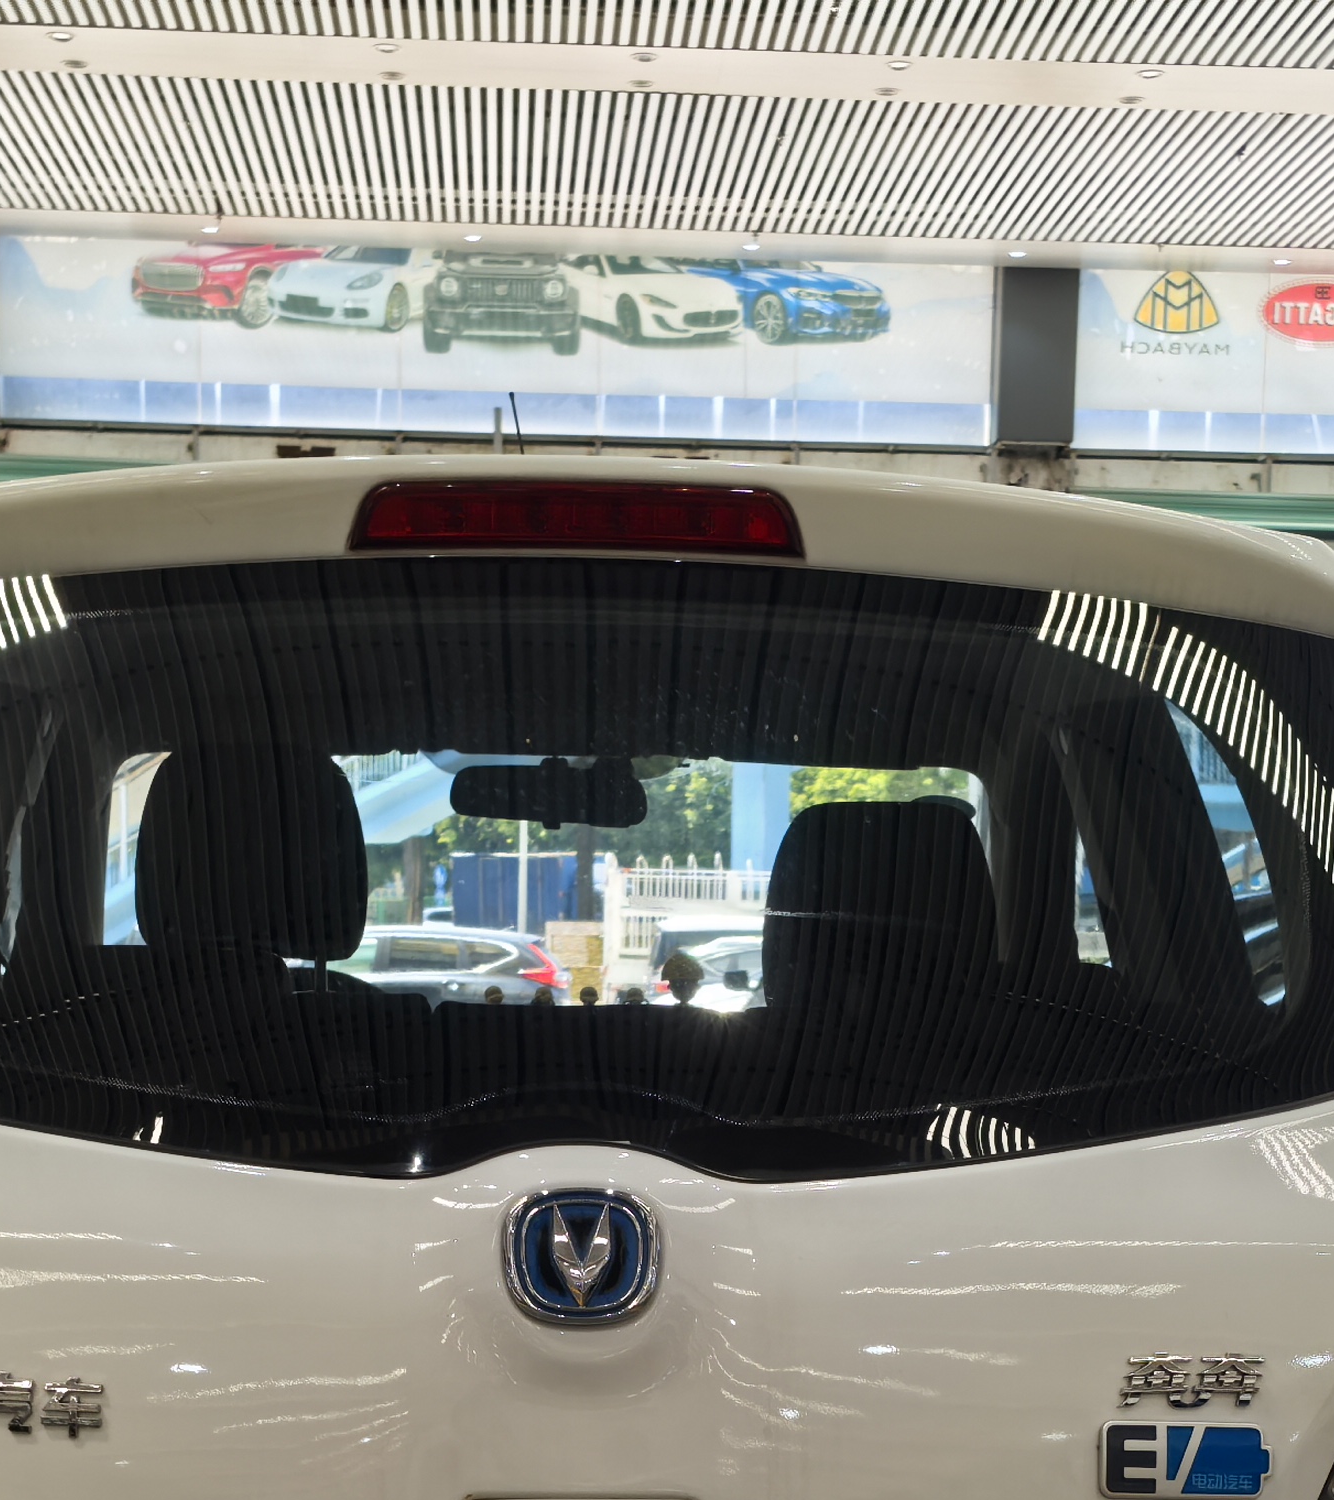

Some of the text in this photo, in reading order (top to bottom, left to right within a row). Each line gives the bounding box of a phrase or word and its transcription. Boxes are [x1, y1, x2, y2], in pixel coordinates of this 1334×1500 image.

[1116, 1351, 1266, 1410] 奔奔
[1191, 1472, 1253, 1490] 电动汽车
